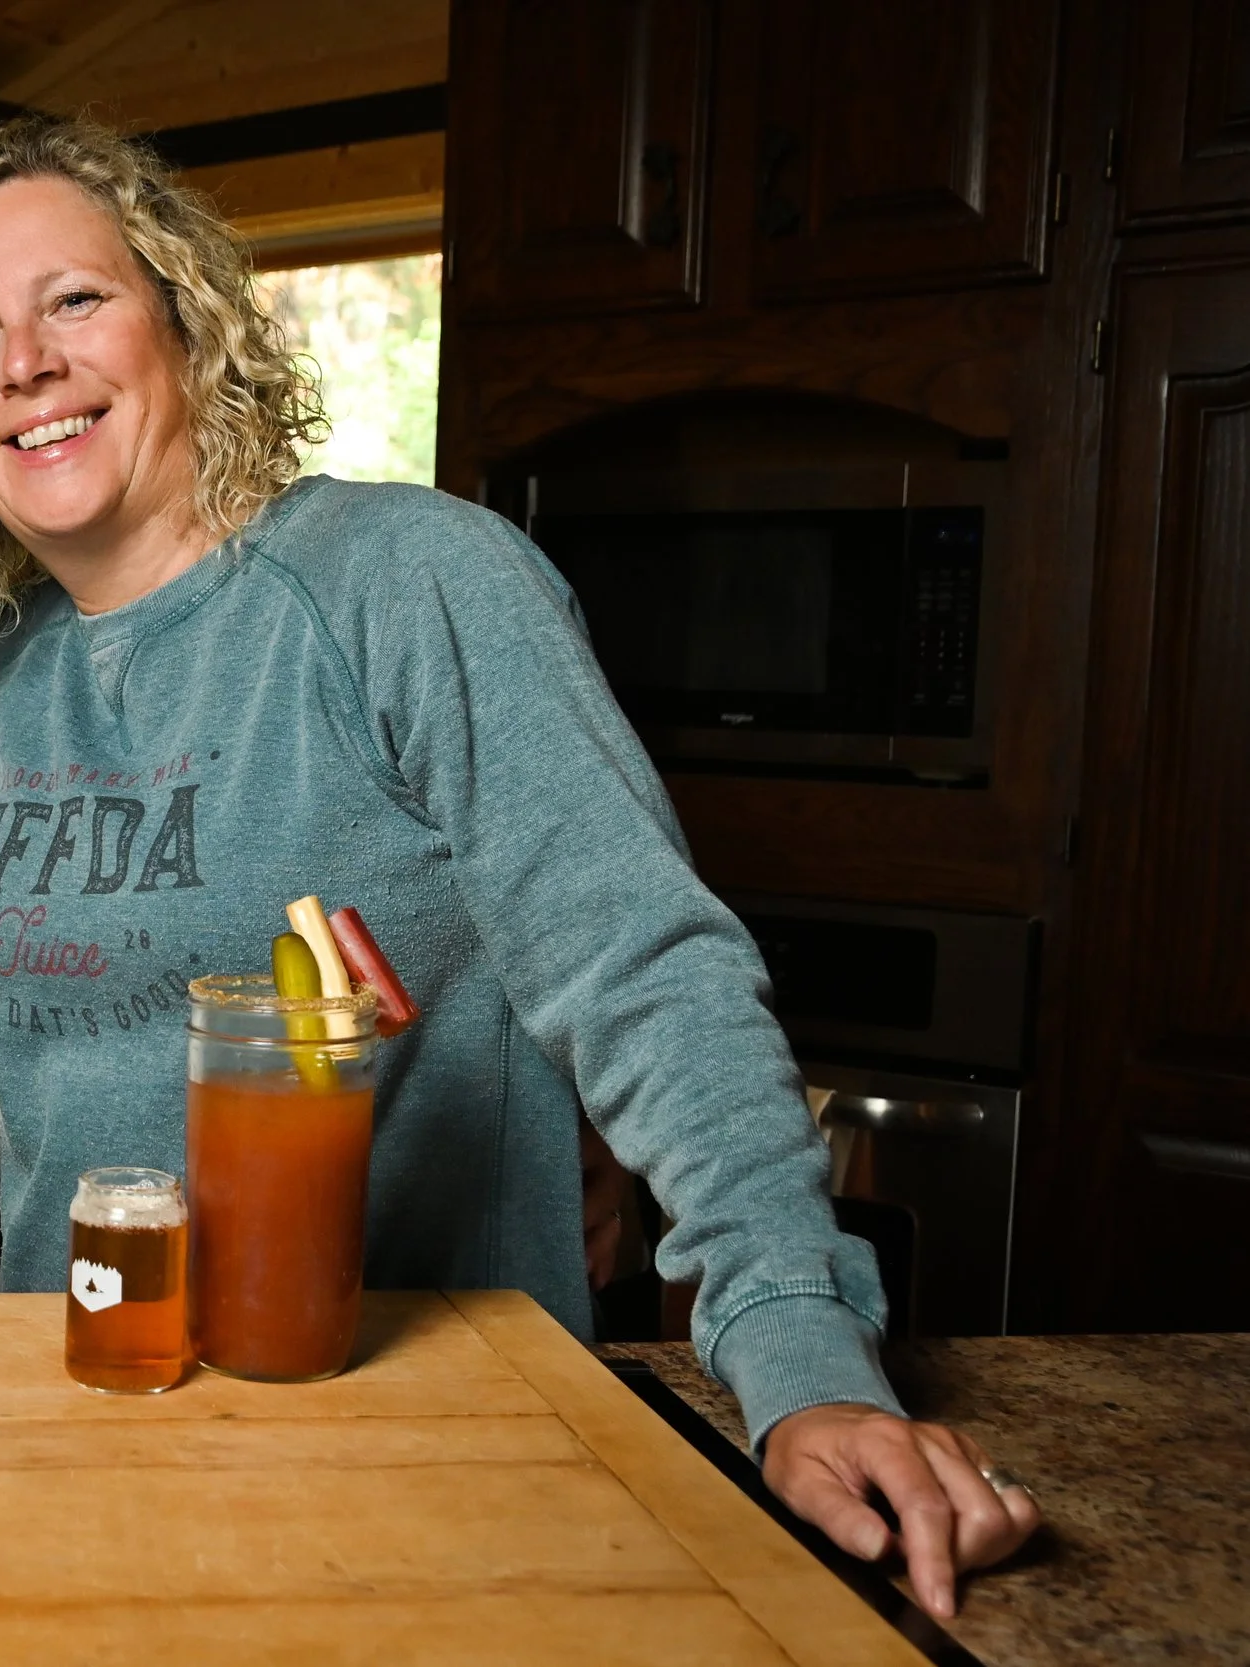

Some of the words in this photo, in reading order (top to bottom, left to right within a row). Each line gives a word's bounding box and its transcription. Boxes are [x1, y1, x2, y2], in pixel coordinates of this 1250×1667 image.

[123, 928, 151, 949] 20
[8, 996, 99, 1037] DAT'S
[112, 968, 190, 1031] GOOD
